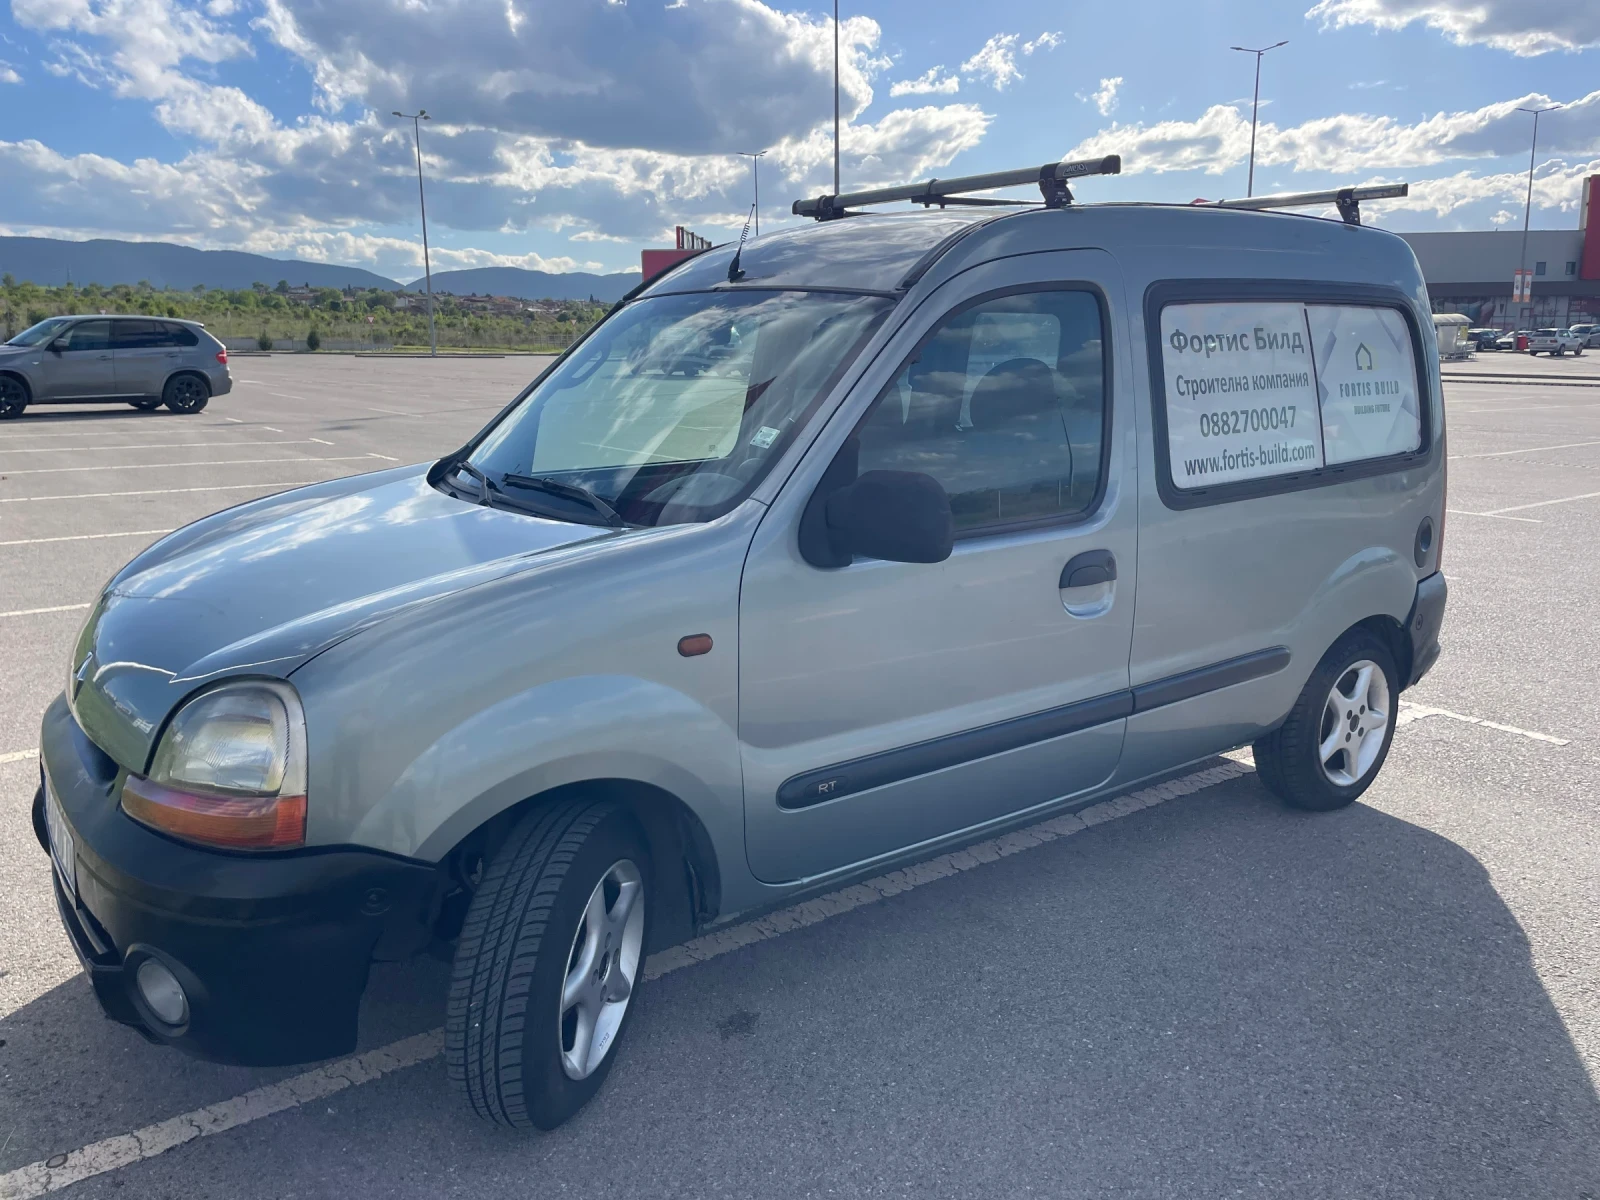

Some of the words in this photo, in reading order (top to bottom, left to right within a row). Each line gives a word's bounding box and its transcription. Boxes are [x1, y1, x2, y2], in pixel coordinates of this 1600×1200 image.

[1170, 329, 1250, 358] Фортис
[1253, 328, 1305, 354] Билд
[1176, 374, 1250, 400] Строителна
[1252, 371, 1309, 391] компания
[1339, 382, 1372, 398] FORTIS
[1374, 380, 1400, 396] BUILD
[1200, 405, 1297, 438] 0882700047
[1184, 441, 1316, 476] www.fortis-build.com
[818, 780, 837, 794] RT
